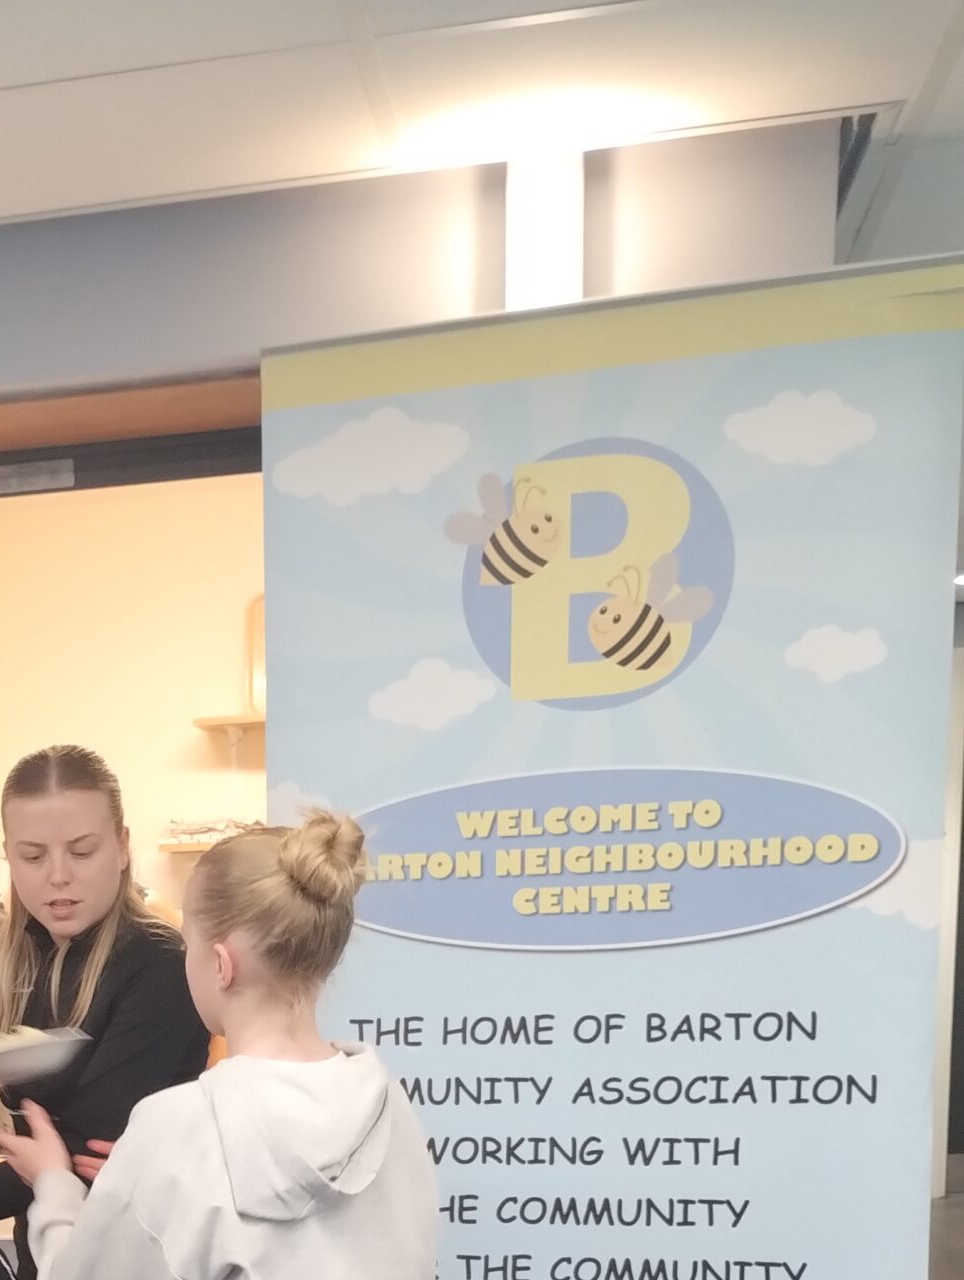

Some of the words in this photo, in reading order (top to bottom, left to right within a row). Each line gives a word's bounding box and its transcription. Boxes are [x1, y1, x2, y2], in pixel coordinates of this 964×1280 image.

[456, 801, 660, 840] WELCOME
[669, 798, 723, 831] TO
[495, 833, 881, 878] NEIGHBOURHOOD
[512, 882, 673, 916] CENTRE
[349, 1016, 425, 1047] THE
[442, 1014, 555, 1046] HOME
[573, 1013, 626, 1045] OF
[646, 1011, 818, 1043] BARTON
[571, 1074, 879, 1105] ASSOCIATION
[622, 1136, 741, 1166] WITH
[496, 1196, 750, 1228] COMMUNITY
